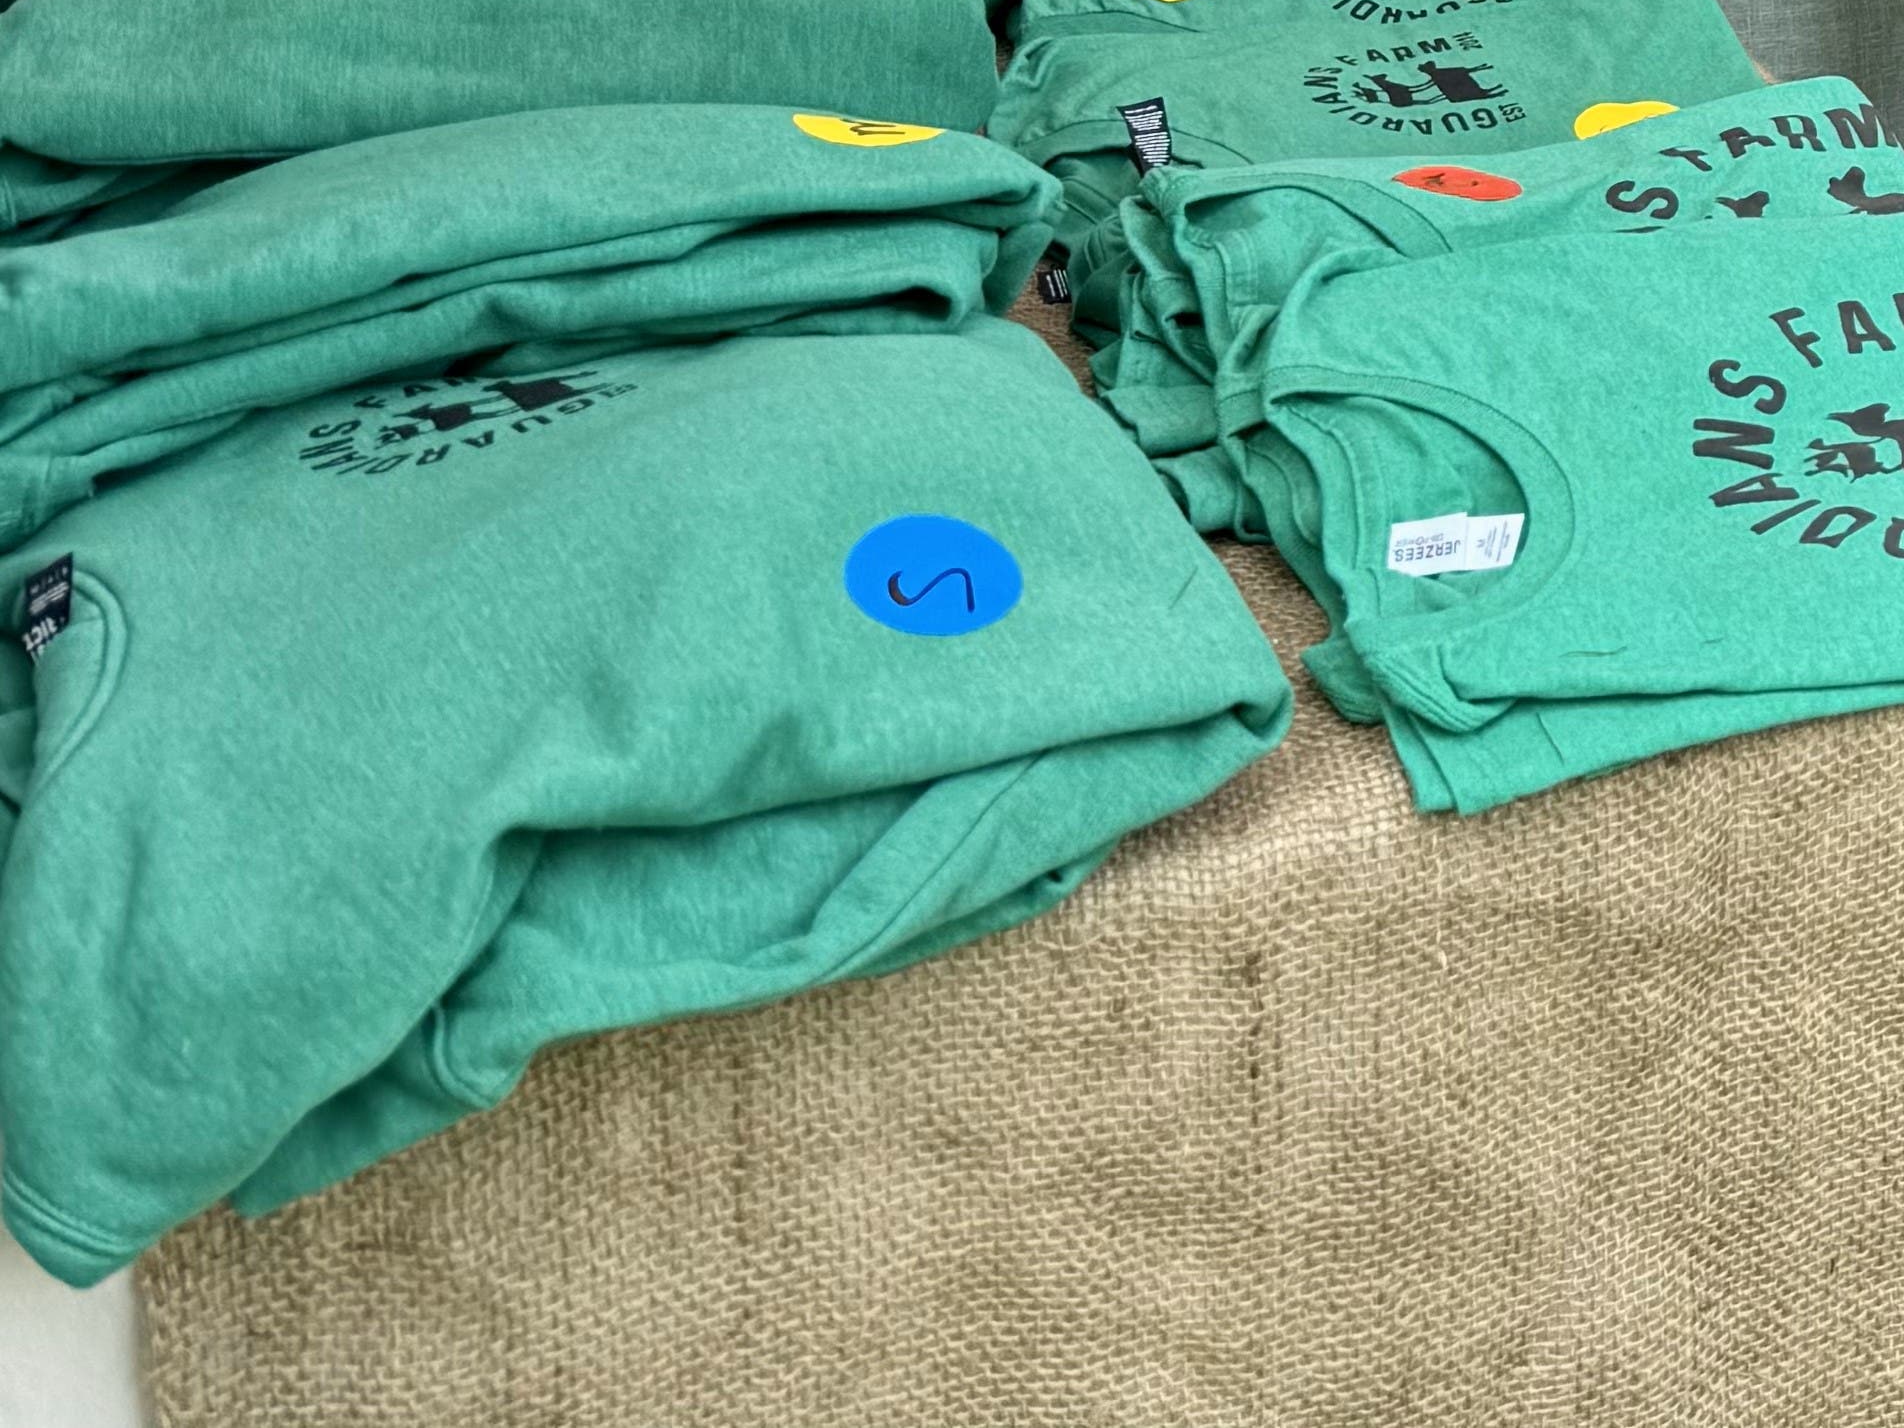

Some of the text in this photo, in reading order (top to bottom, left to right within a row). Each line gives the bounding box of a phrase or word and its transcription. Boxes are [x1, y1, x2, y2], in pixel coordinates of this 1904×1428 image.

[1303, 37, 1499, 135] GUARDIANS FARM
[1498, 101, 1527, 124] EST
[299, 398, 595, 476] GUARDIANS
